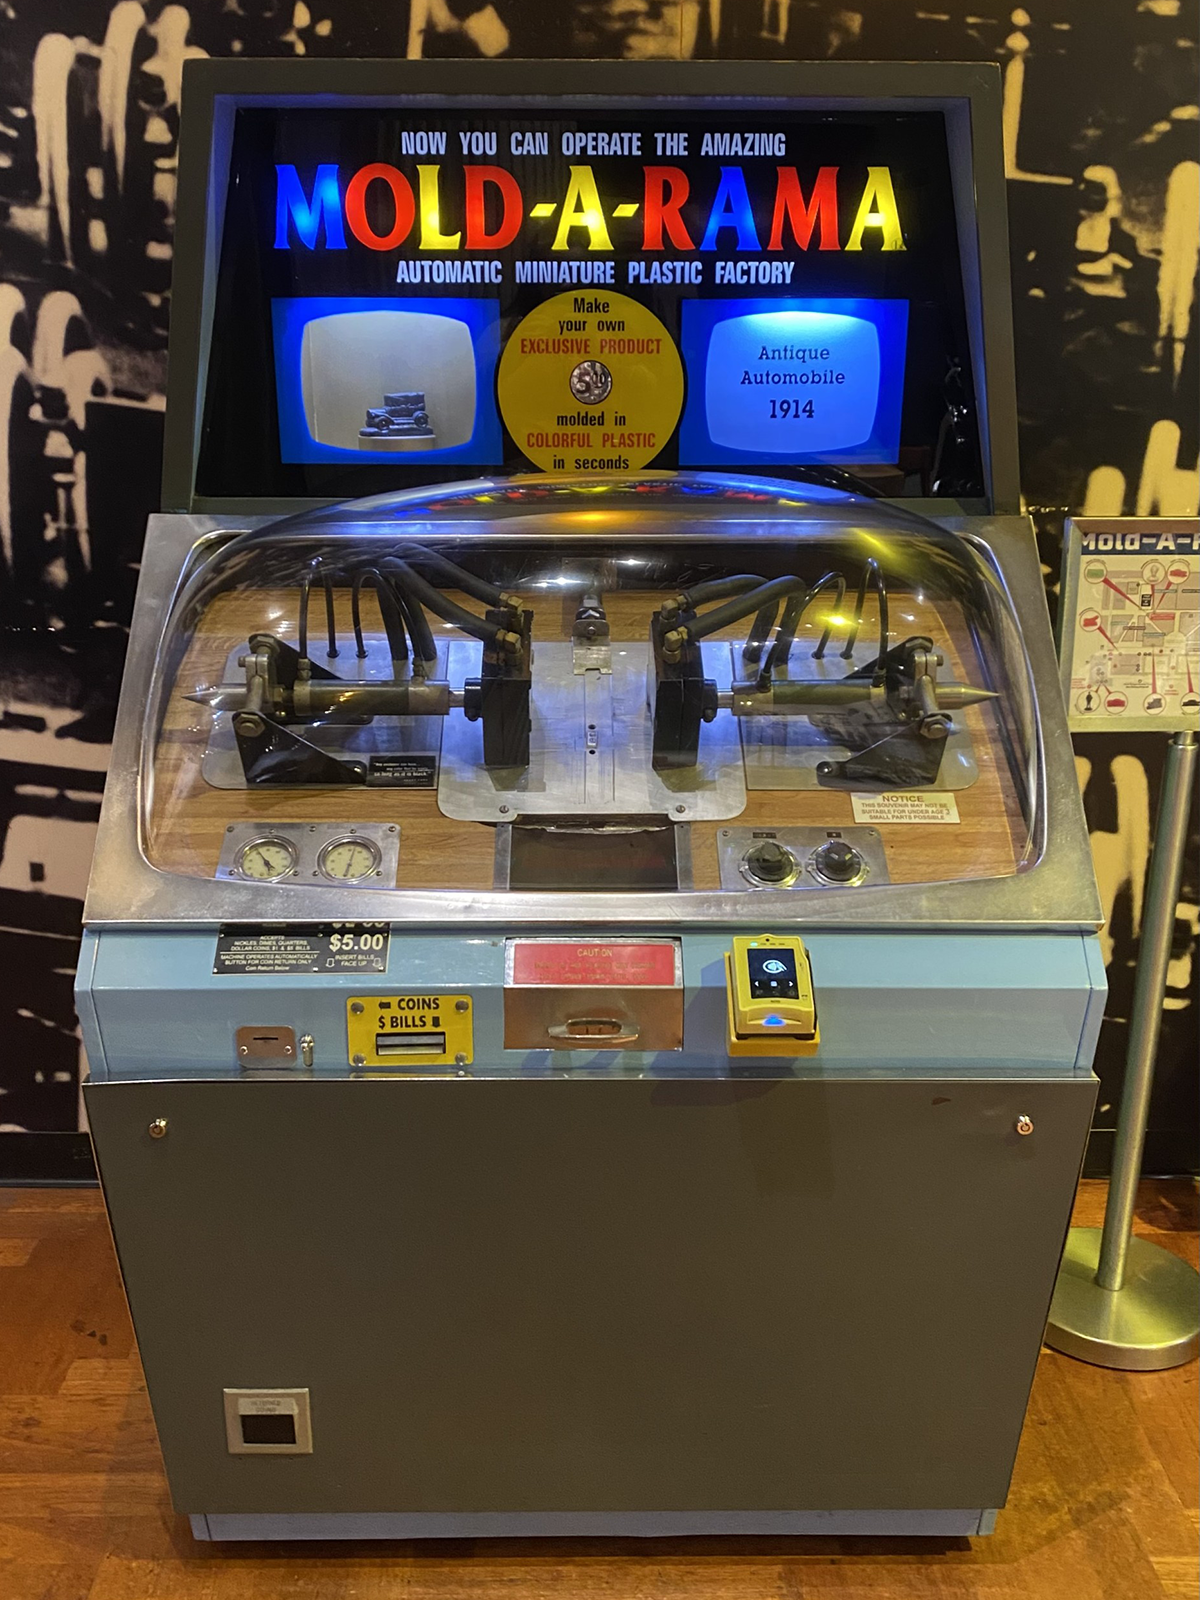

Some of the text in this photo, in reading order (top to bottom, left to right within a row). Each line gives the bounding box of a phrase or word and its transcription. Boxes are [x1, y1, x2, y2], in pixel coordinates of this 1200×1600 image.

[401, 131, 786, 156] NOW YOU CAN OPERATE THE AMAZING
[273, 162, 907, 251] MOLD-A-RAMA
[396, 260, 795, 284] AUTOMATIC MINIATURE PLASTIC FACTORY
[573, 297, 610, 313] Make
[558, 320, 625, 335] your own
[520, 338, 662, 354] EXCLUSIVE PRODUCT
[758, 345, 830, 363] Antique
[740, 370, 846, 385] Automobile
[769, 399, 815, 419] 1914
[556, 411, 626, 426] molded in
[527, 432, 656, 448] COLORFUL PLASTIC
[553, 455, 629, 470] in seconds
[329, 933, 383, 952] $5.00
[577, 948, 613, 957] CAUTON
[397, 997, 440, 1010] COINS
[378, 1015, 427, 1030] $ BILLS
